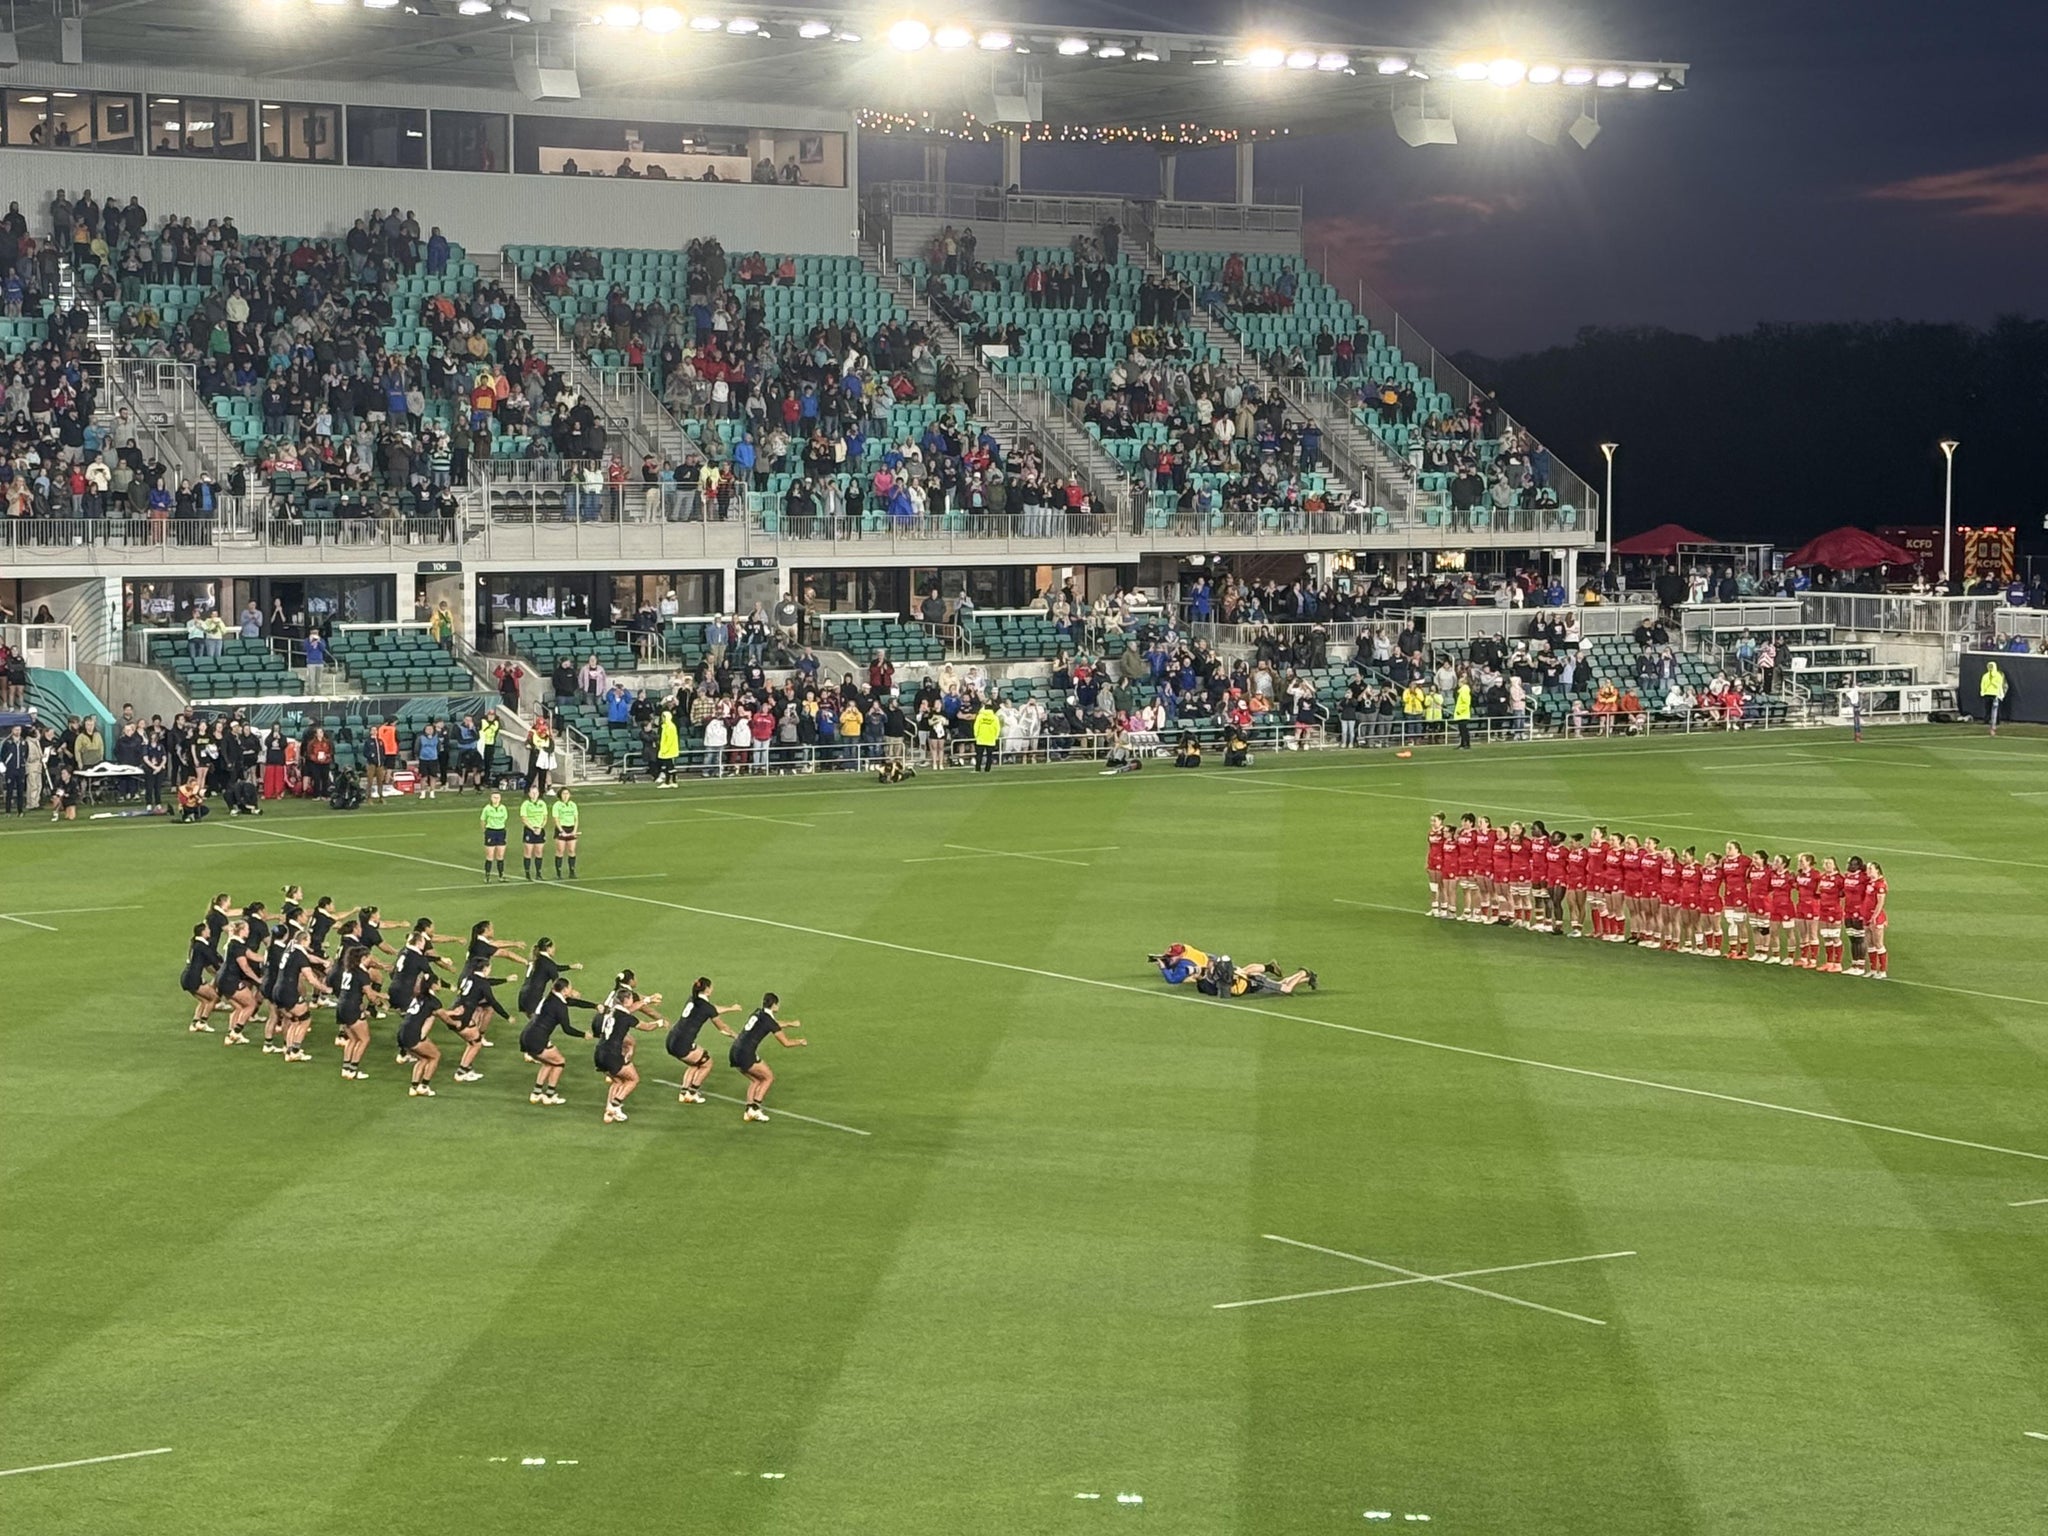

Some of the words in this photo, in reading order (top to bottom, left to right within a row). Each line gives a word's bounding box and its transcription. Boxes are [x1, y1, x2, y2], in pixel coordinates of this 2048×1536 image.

[1905, 539, 1932, 549] KCFD
[432, 562, 447, 571] 106
[1976, 559, 2002, 568] KCFD
